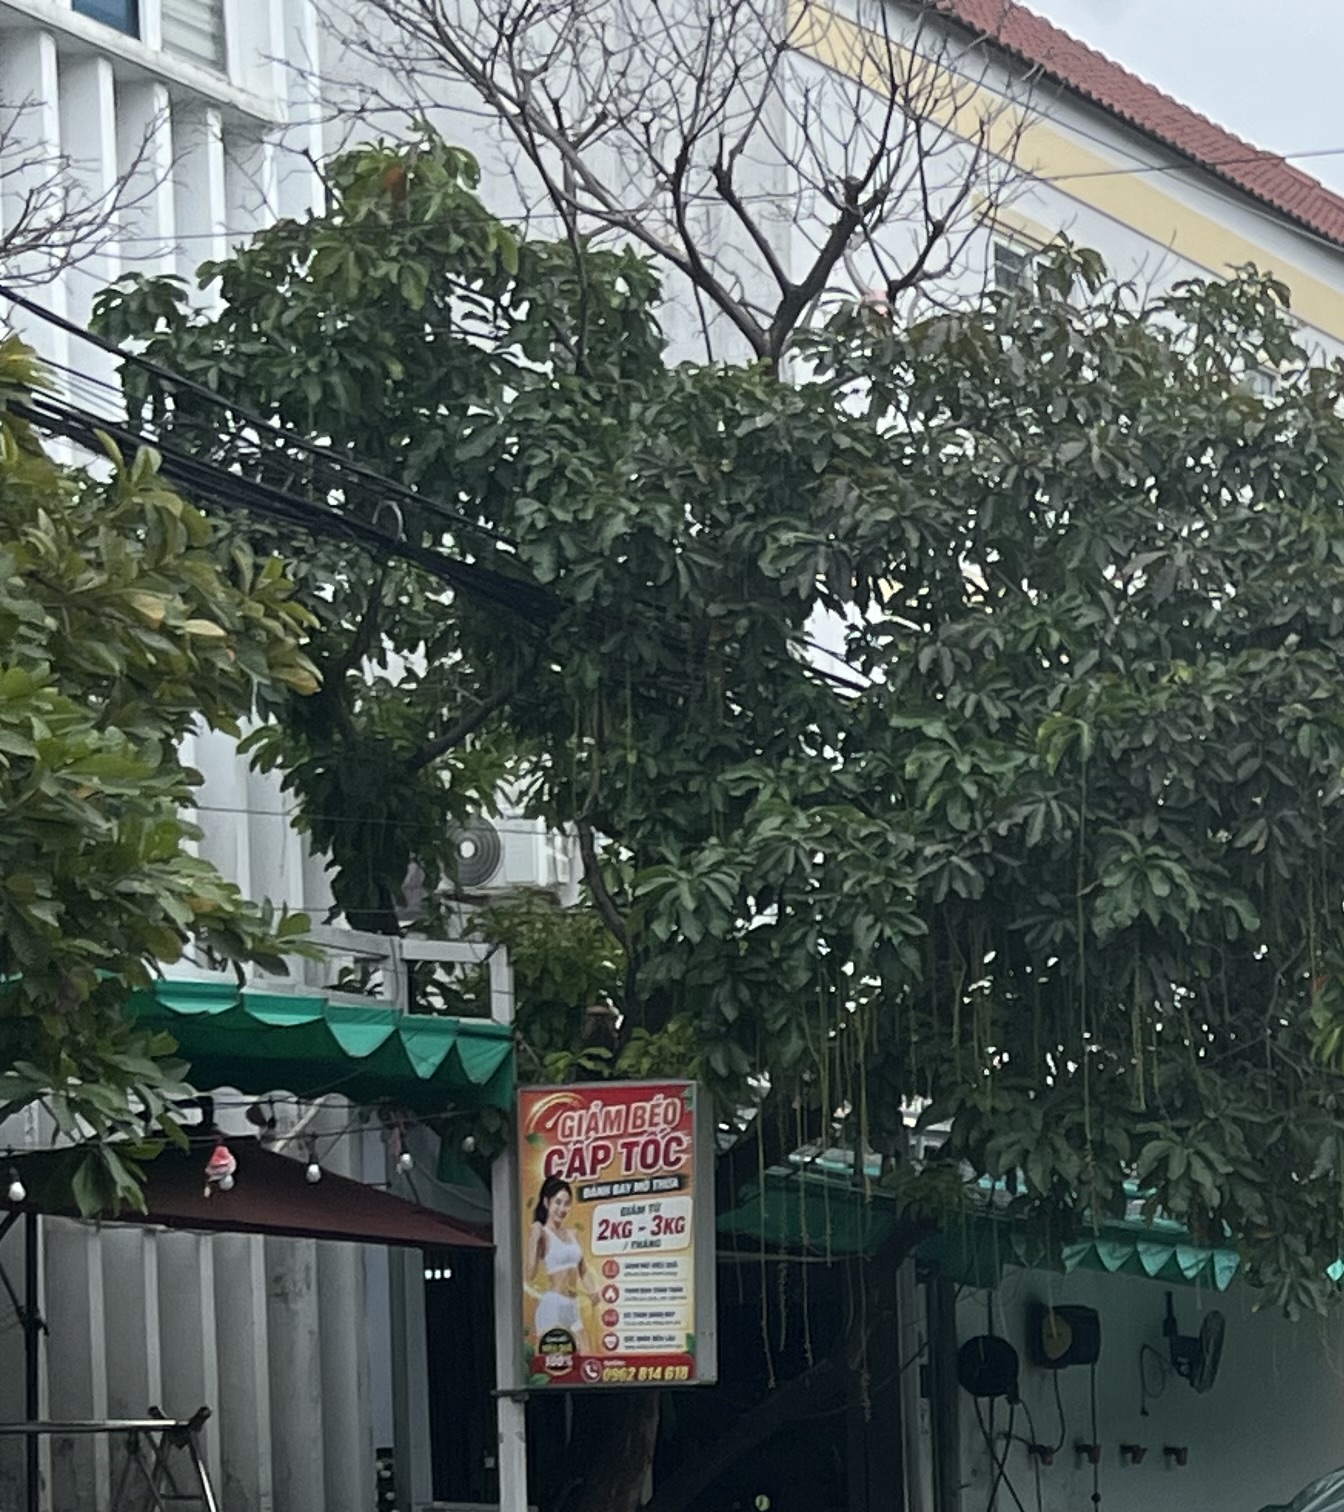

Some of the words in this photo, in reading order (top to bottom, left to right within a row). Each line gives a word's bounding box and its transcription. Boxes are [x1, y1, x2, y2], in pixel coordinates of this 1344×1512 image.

[557, 1101, 627, 1142] GIẢM
[628, 1094, 681, 1133] BÉO
[544, 1136, 613, 1181] CẤP
[618, 1126, 687, 1174] TỐC
[597, 1218, 633, 1242] 2KG
[650, 1214, 686, 1237] 3KG
